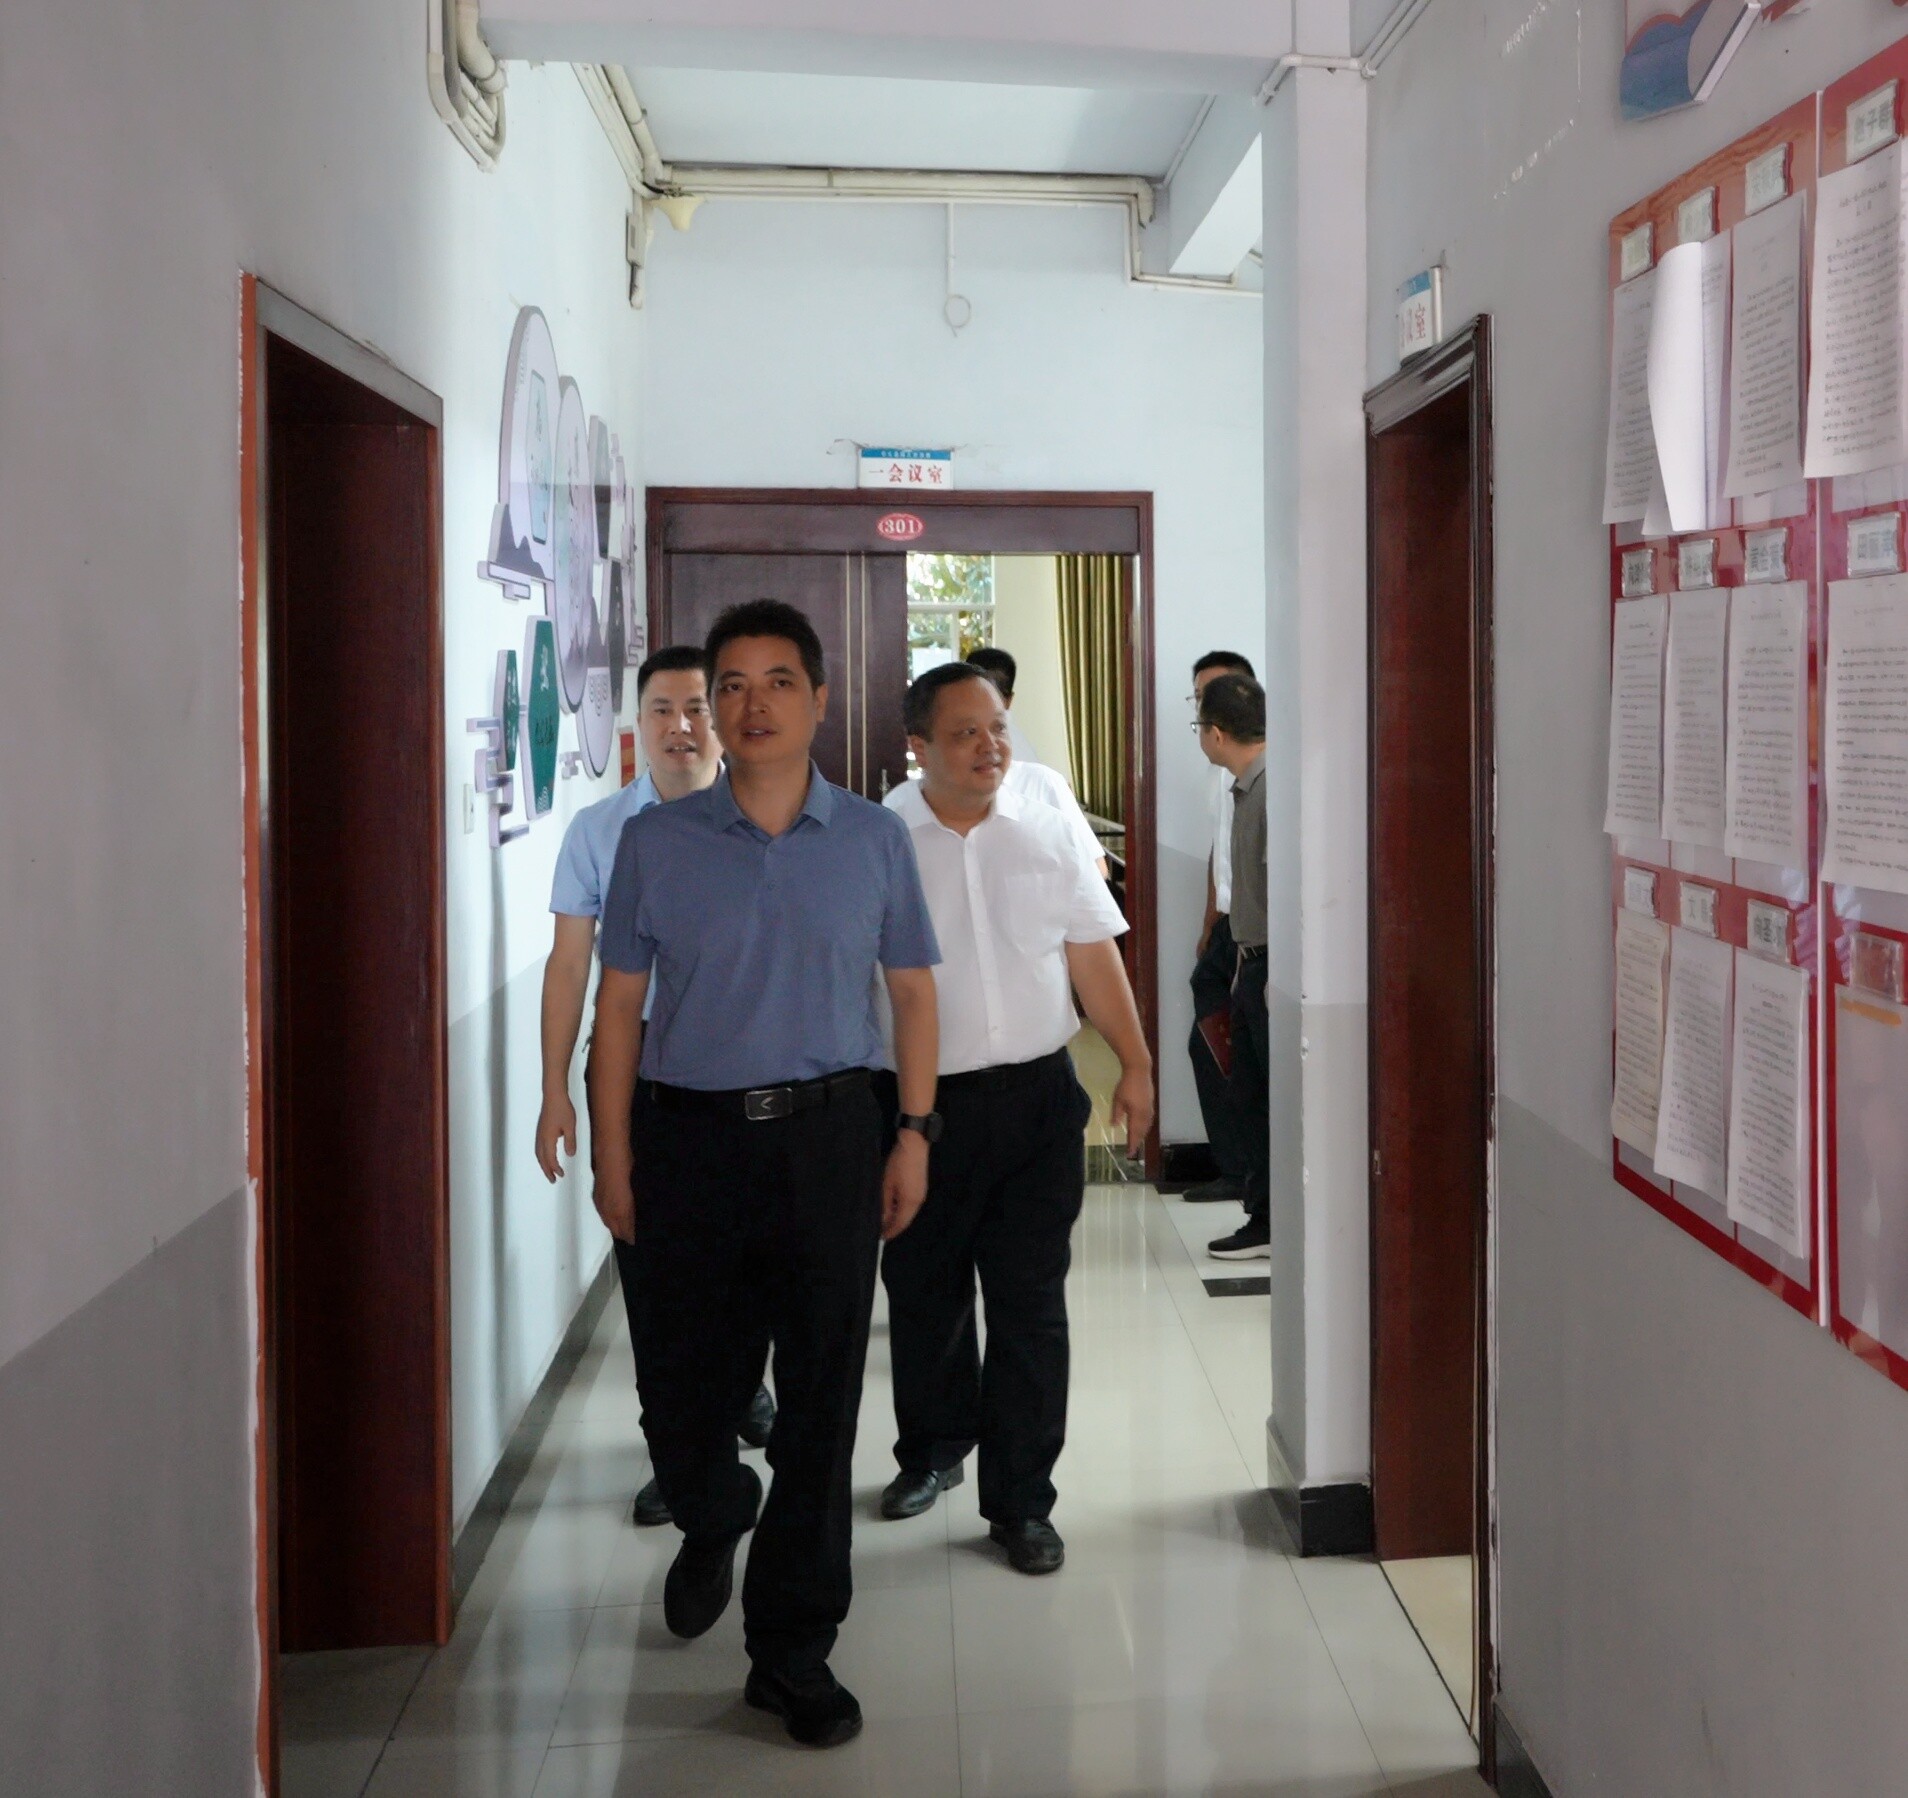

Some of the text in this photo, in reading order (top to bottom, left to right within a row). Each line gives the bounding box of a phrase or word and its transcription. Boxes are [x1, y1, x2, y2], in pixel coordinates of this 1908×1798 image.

[868, 463, 943, 484] 一会议室
[884, 518, 915, 534] 301
